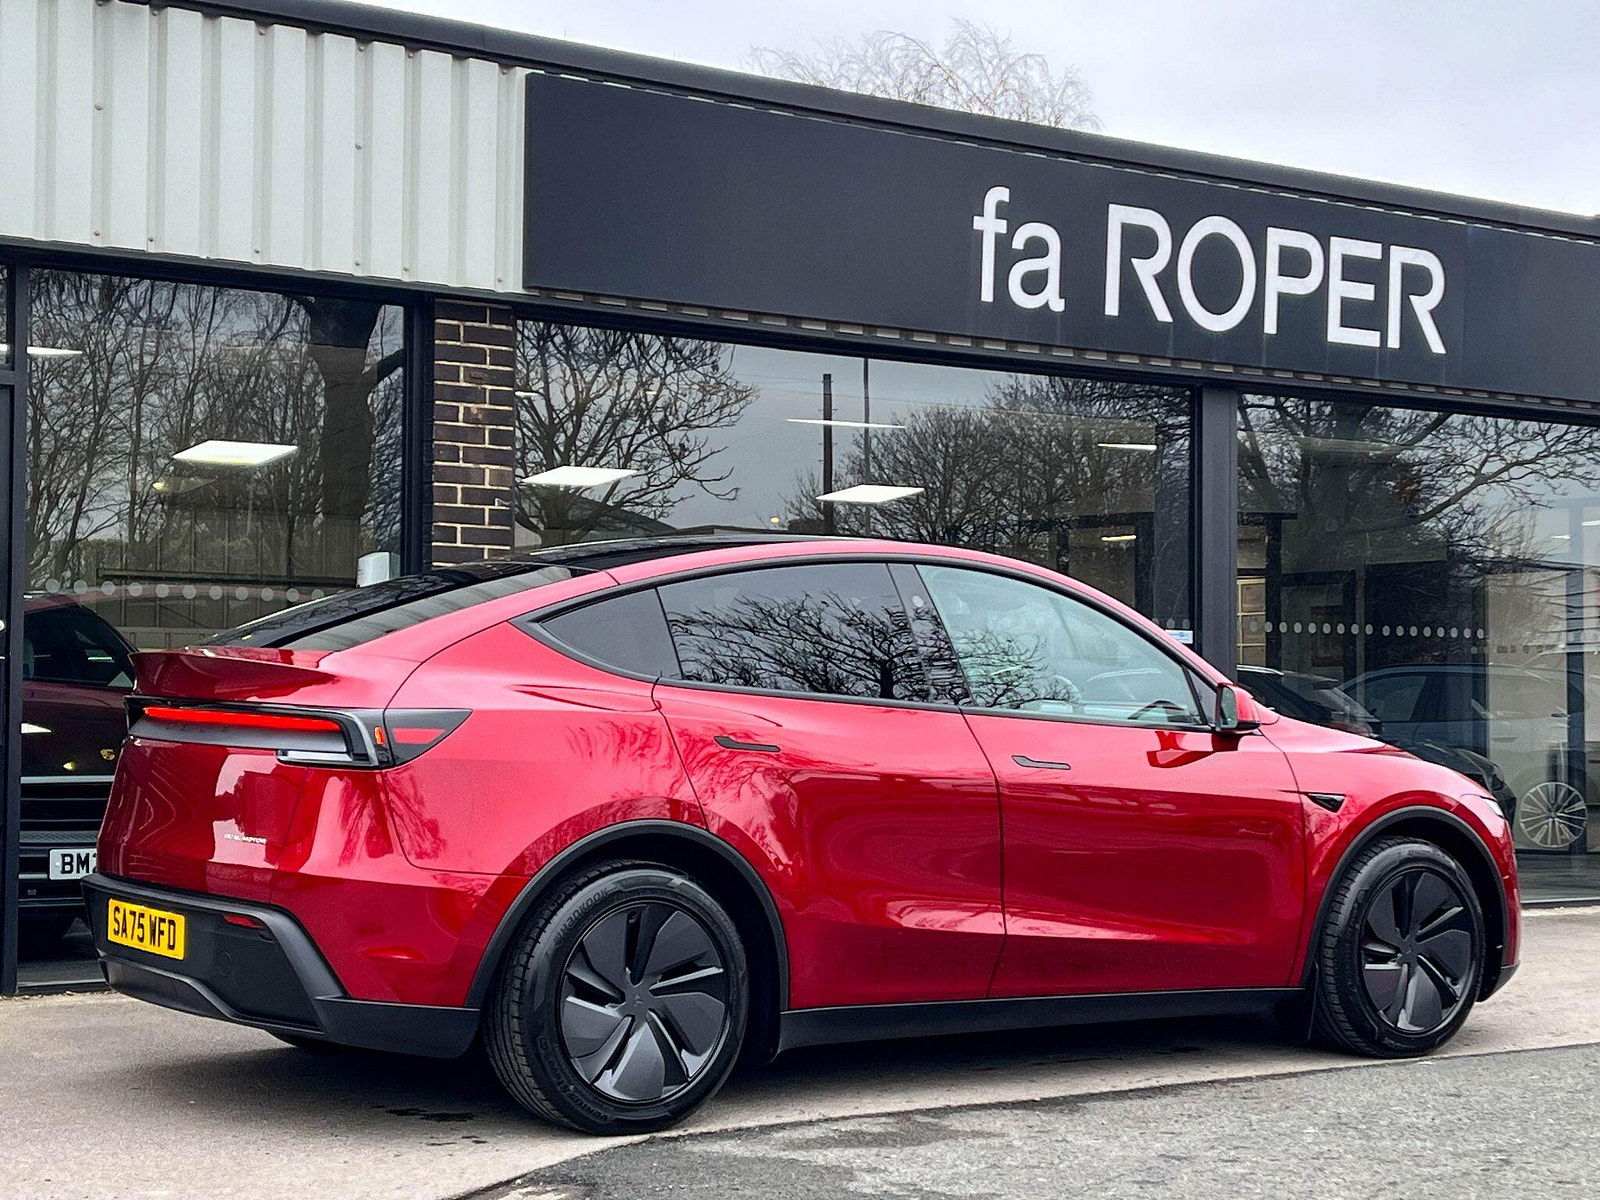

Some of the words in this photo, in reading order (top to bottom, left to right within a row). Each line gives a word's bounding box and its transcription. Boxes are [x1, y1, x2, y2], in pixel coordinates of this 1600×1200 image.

[972, 186, 1065, 312] fa
[1104, 203, 1447, 354] ROPER
[113, 906, 145, 943] SA75
[149, 914, 176, 950] WFD
